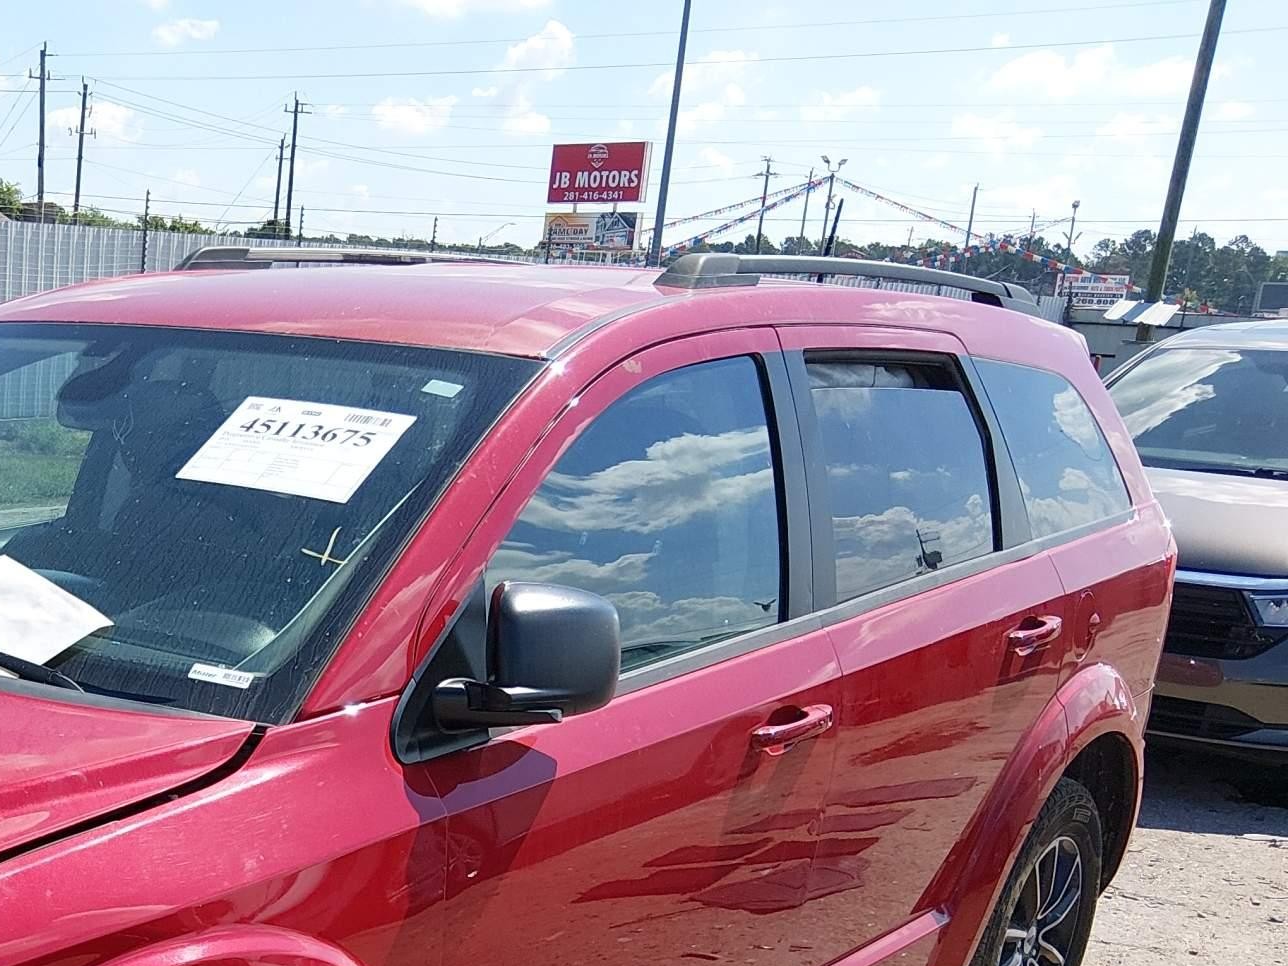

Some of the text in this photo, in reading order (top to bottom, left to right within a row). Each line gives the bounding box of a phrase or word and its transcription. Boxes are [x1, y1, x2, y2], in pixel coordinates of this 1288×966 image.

[553, 169, 639, 189] JB MOTORS
[563, 190, 623, 201] 281-416-4341
[239, 417, 377, 448] 45113675
